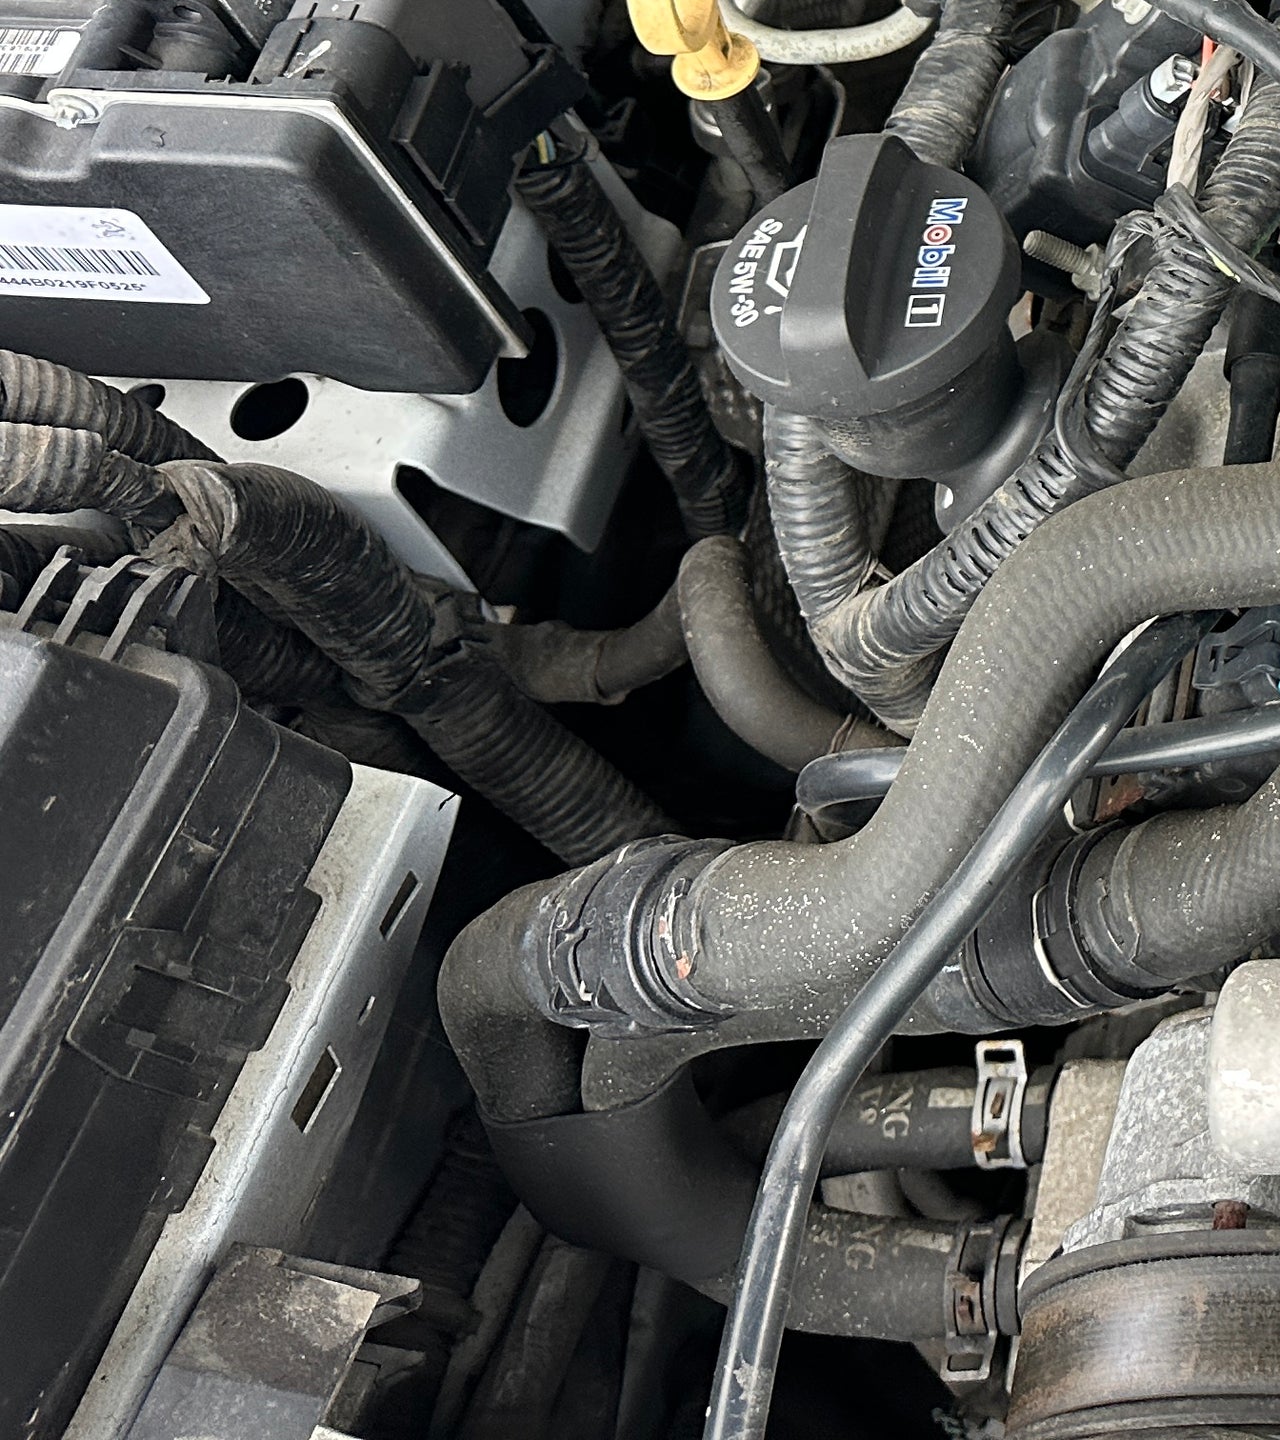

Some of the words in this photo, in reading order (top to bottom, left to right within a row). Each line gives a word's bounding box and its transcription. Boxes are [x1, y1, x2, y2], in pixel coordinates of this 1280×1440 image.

[736, 217, 784, 261] SAE
[911, 197, 969, 289] Mobil
[729, 259, 760, 328] 5W-30
[882, 1076, 914, 1140] NG
